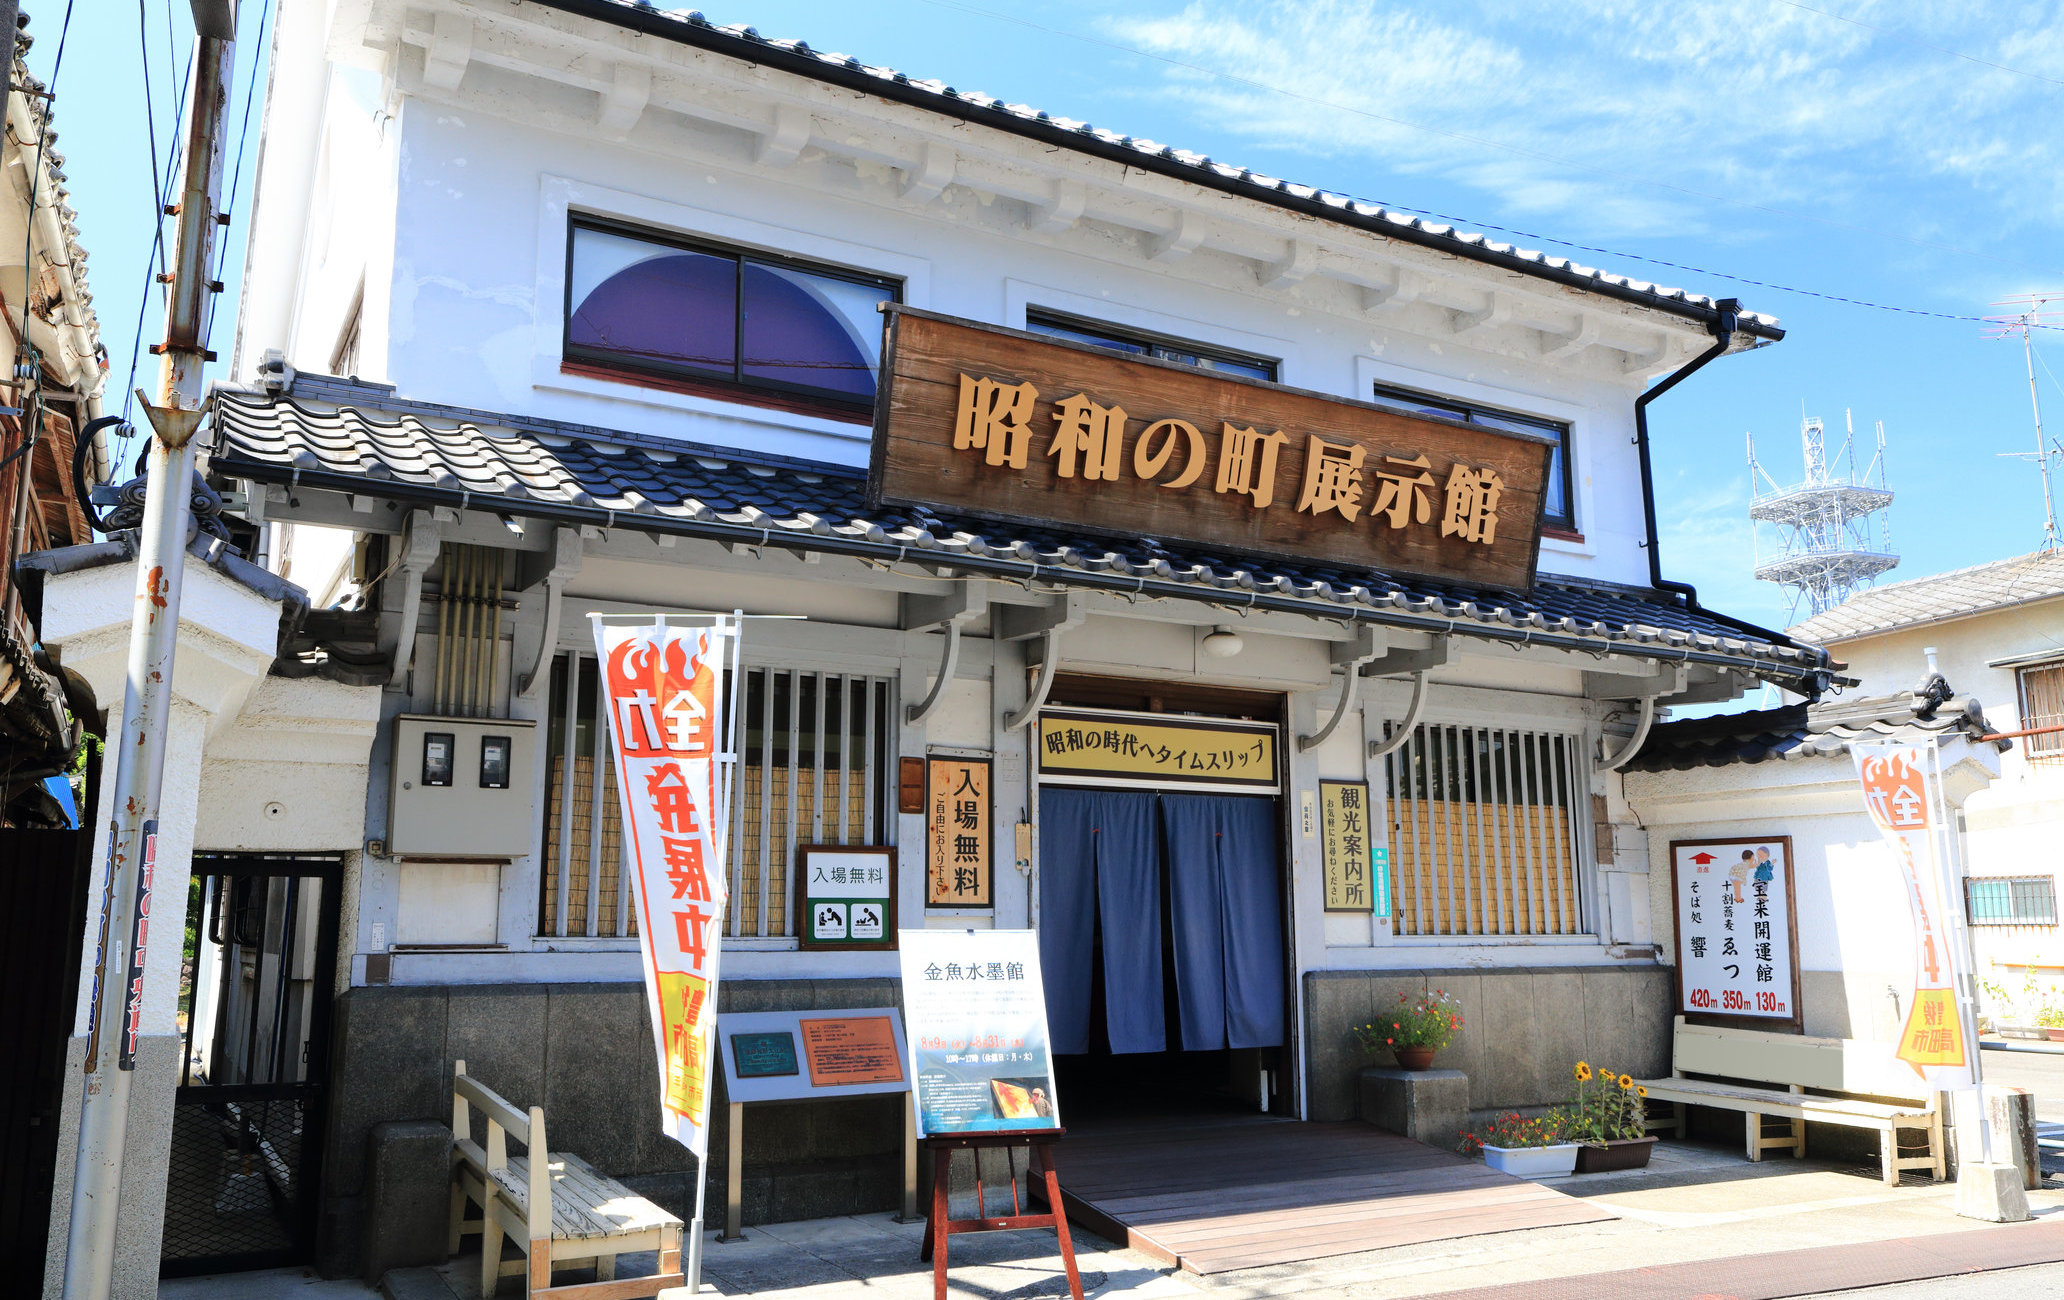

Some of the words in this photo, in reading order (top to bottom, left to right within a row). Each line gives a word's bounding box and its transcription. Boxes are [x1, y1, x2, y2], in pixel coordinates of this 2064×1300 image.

[953, 372, 1504, 545] 昭和の町展示館
[1046, 727, 1264, 771] 昭和の時代へタイムスリップ
[935, 792, 946, 896] ご自由にお入り下さい
[953, 769, 981, 896] 入場無料
[1327, 799, 1338, 905] お気軽にお尋ねください
[1341, 788, 1365, 905] 観光案内所
[813, 867, 883, 884] 入場無料
[1690, 881, 1703, 924] そば処
[1721, 880, 1735, 932] 十割蕎麦
[1690, 936, 1707, 958] 響
[1752, 879, 1773, 983] 宝来開運館
[924, 961, 1025, 981] 金魚水墨館
[1690, 988, 1718, 1009] 420m
[1722, 989, 1752, 1011] 350m
[1755, 991, 1786, 1012] 130m
